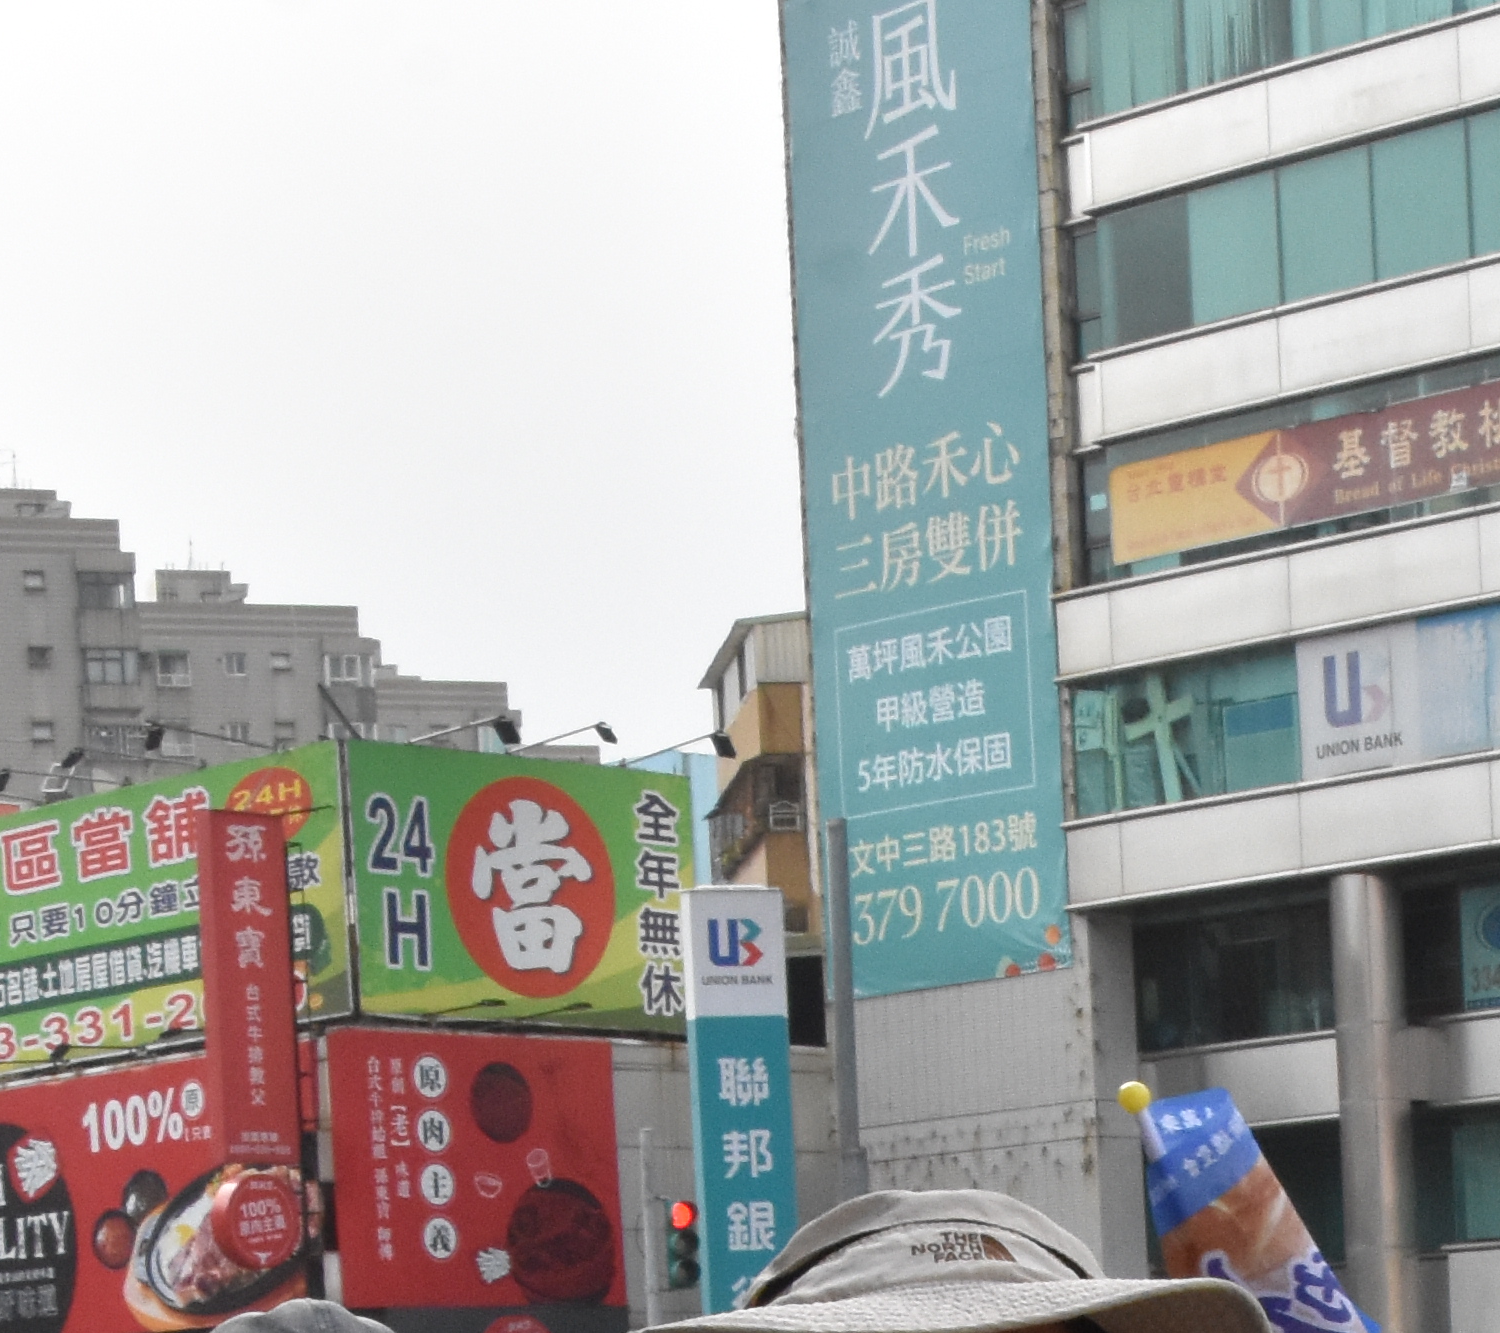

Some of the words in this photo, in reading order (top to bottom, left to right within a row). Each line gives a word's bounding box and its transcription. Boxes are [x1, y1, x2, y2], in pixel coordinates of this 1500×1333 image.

[864, 0, 962, 399] 風禾秀
[963, 228, 1011, 257] Fresh
[964, 259, 1006, 285] Start
[831, 421, 1022, 522] 中路禾心
[1334, 478, 1380, 506] Bread
[1388, 476, 1404, 495] of
[1411, 468, 1443, 490] Life
[835, 499, 1024, 600] 三房雙併
[847, 614, 1013, 684] 萬坪風禾公園
[876, 678, 987, 732] 甲級營造
[857, 731, 1013, 793] 5年防水保固
[1316, 740, 1360, 761] UNION
[1362, 731, 1404, 754] BANK
[365, 791, 435, 877] 24
[850, 811, 1038, 878] 文中三路183號
[224, 823, 273, 970] 孫東寶
[471, 797, 594, 976] 當
[633, 790, 686, 1018] 全年無休
[854, 884, 922, 947] 379
[935, 866, 1041, 932] 7000
[382, 887, 433, 973] H
[701, 973, 739, 986] UNION
[740, 973, 774, 986] BANK
[82, 1086, 184, 1154] 100%
[416, 1060, 454, 1256] 原肉主義
[239, 1198, 283, 1219] 100%
